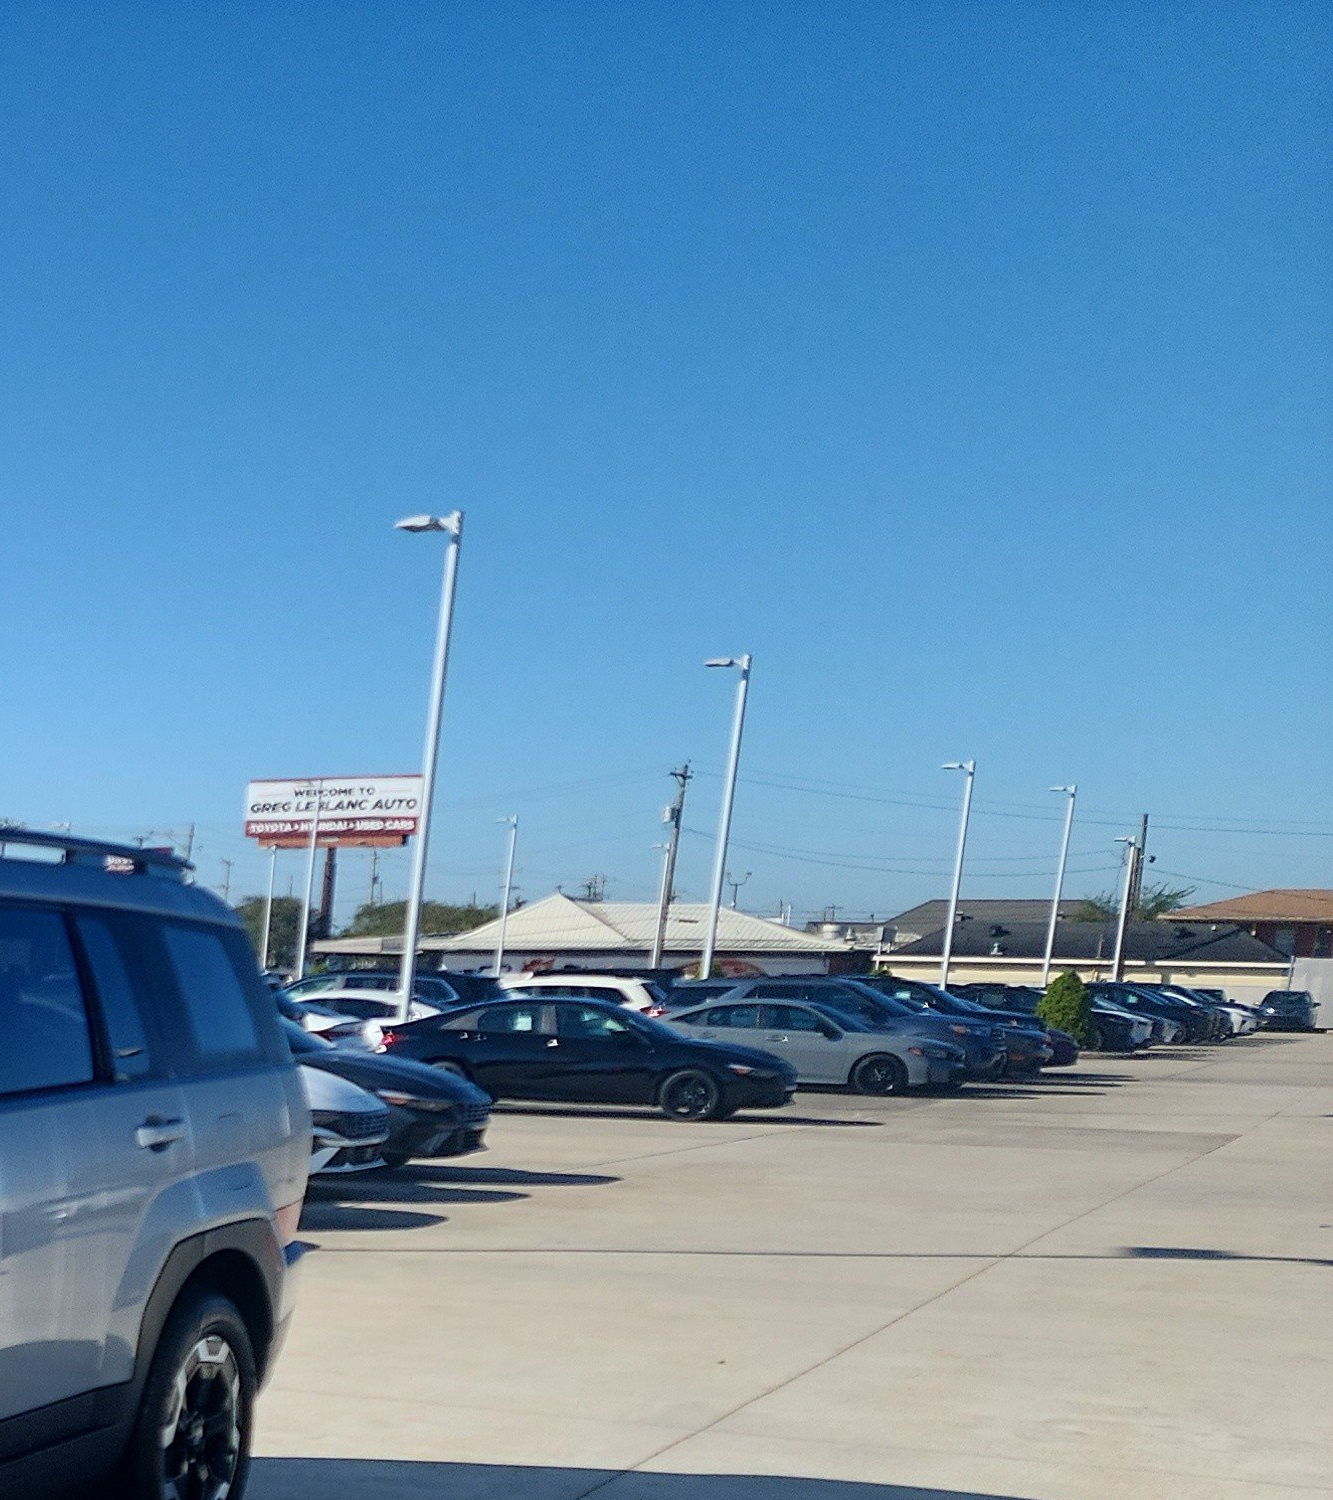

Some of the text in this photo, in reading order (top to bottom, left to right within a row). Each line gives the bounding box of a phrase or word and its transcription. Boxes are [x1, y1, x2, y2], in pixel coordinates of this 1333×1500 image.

[294, 787, 375, 797] WELCOME TO
[250, 802, 291, 814] GREG
[371, 799, 417, 811] AUTO
[250, 818, 416, 833] TOYOTA HYNDAI USED CARS
